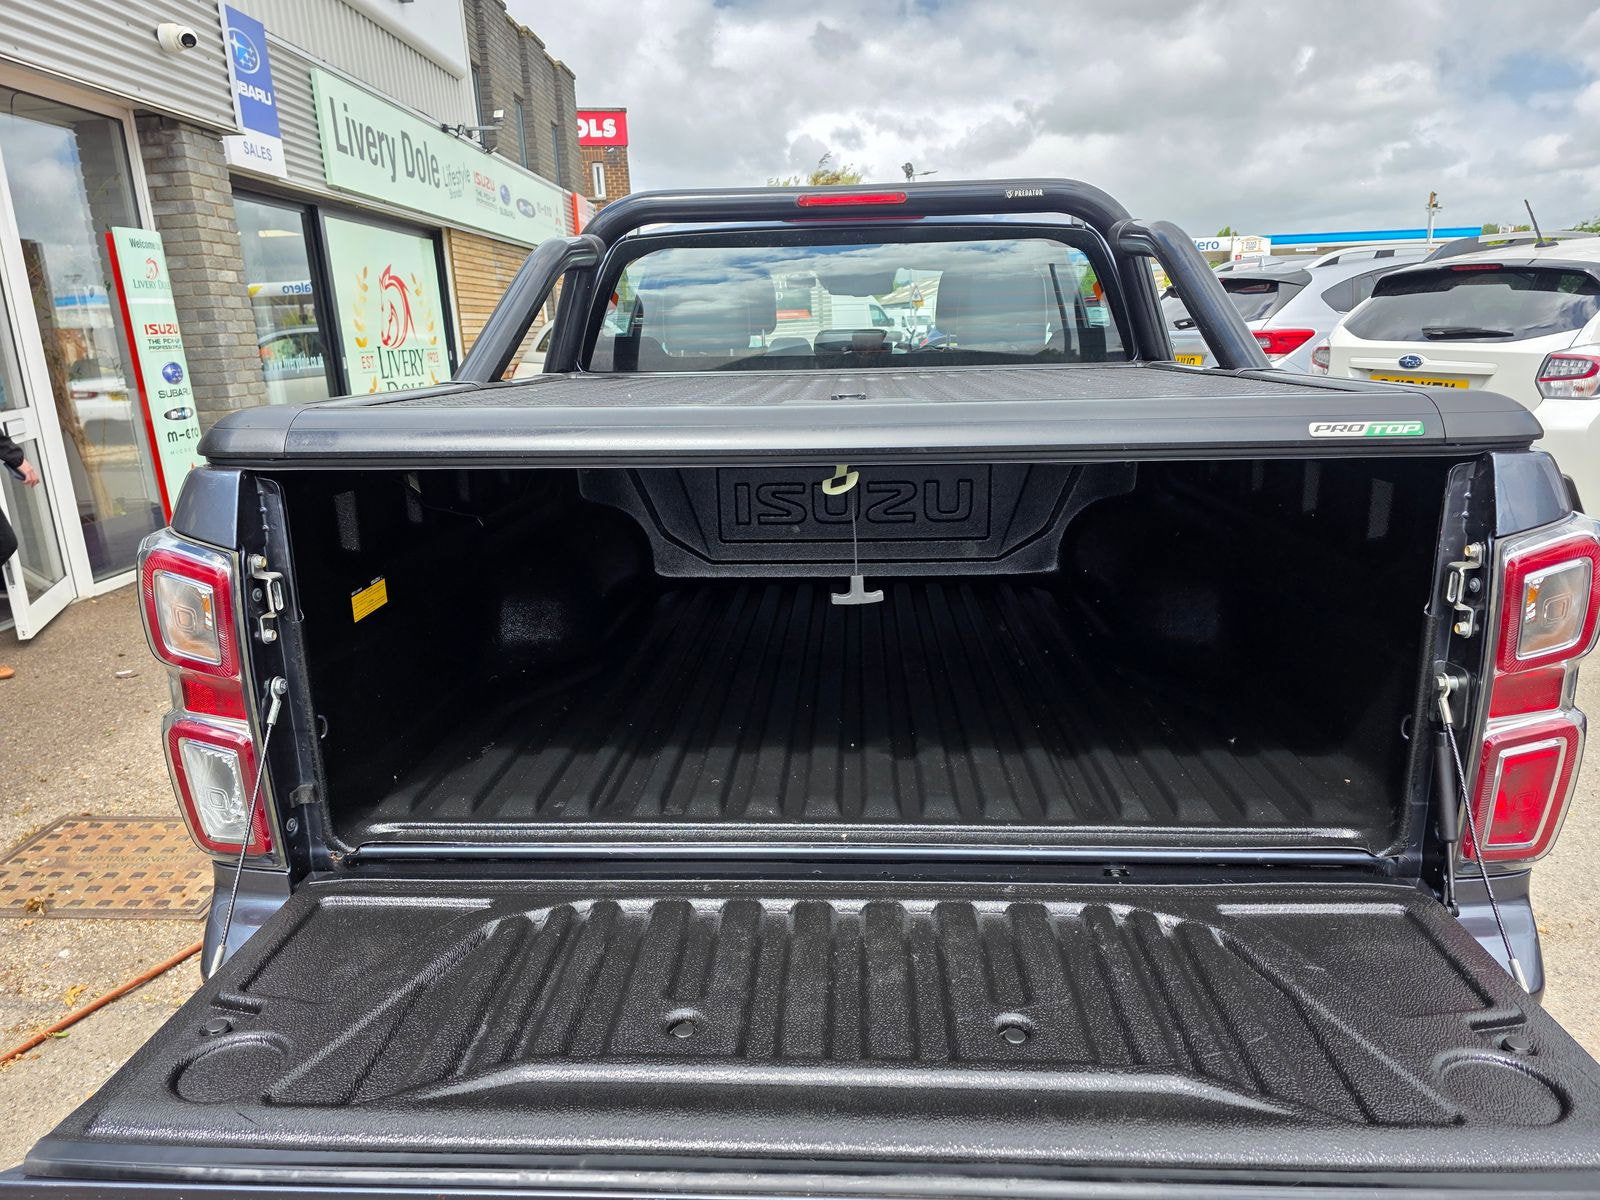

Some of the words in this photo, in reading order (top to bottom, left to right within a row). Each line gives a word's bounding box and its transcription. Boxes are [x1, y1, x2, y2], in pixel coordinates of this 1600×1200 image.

[243, 141, 272, 162] SALES
[329, 96, 397, 183] Livery
[400, 130, 440, 189] Dole
[442, 161, 471, 190] Lifestyle
[473, 169, 496, 192] ISUZU
[1014, 189, 1044, 197] PREDATOR
[129, 238, 156, 250] Welcome
[133, 279, 157, 289] LIVERY
[144, 323, 178, 335] ISUZU
[377, 346, 425, 380] LIVERY
[158, 388, 191, 399] SUBARU
[734, 478, 974, 526] ISUZU
